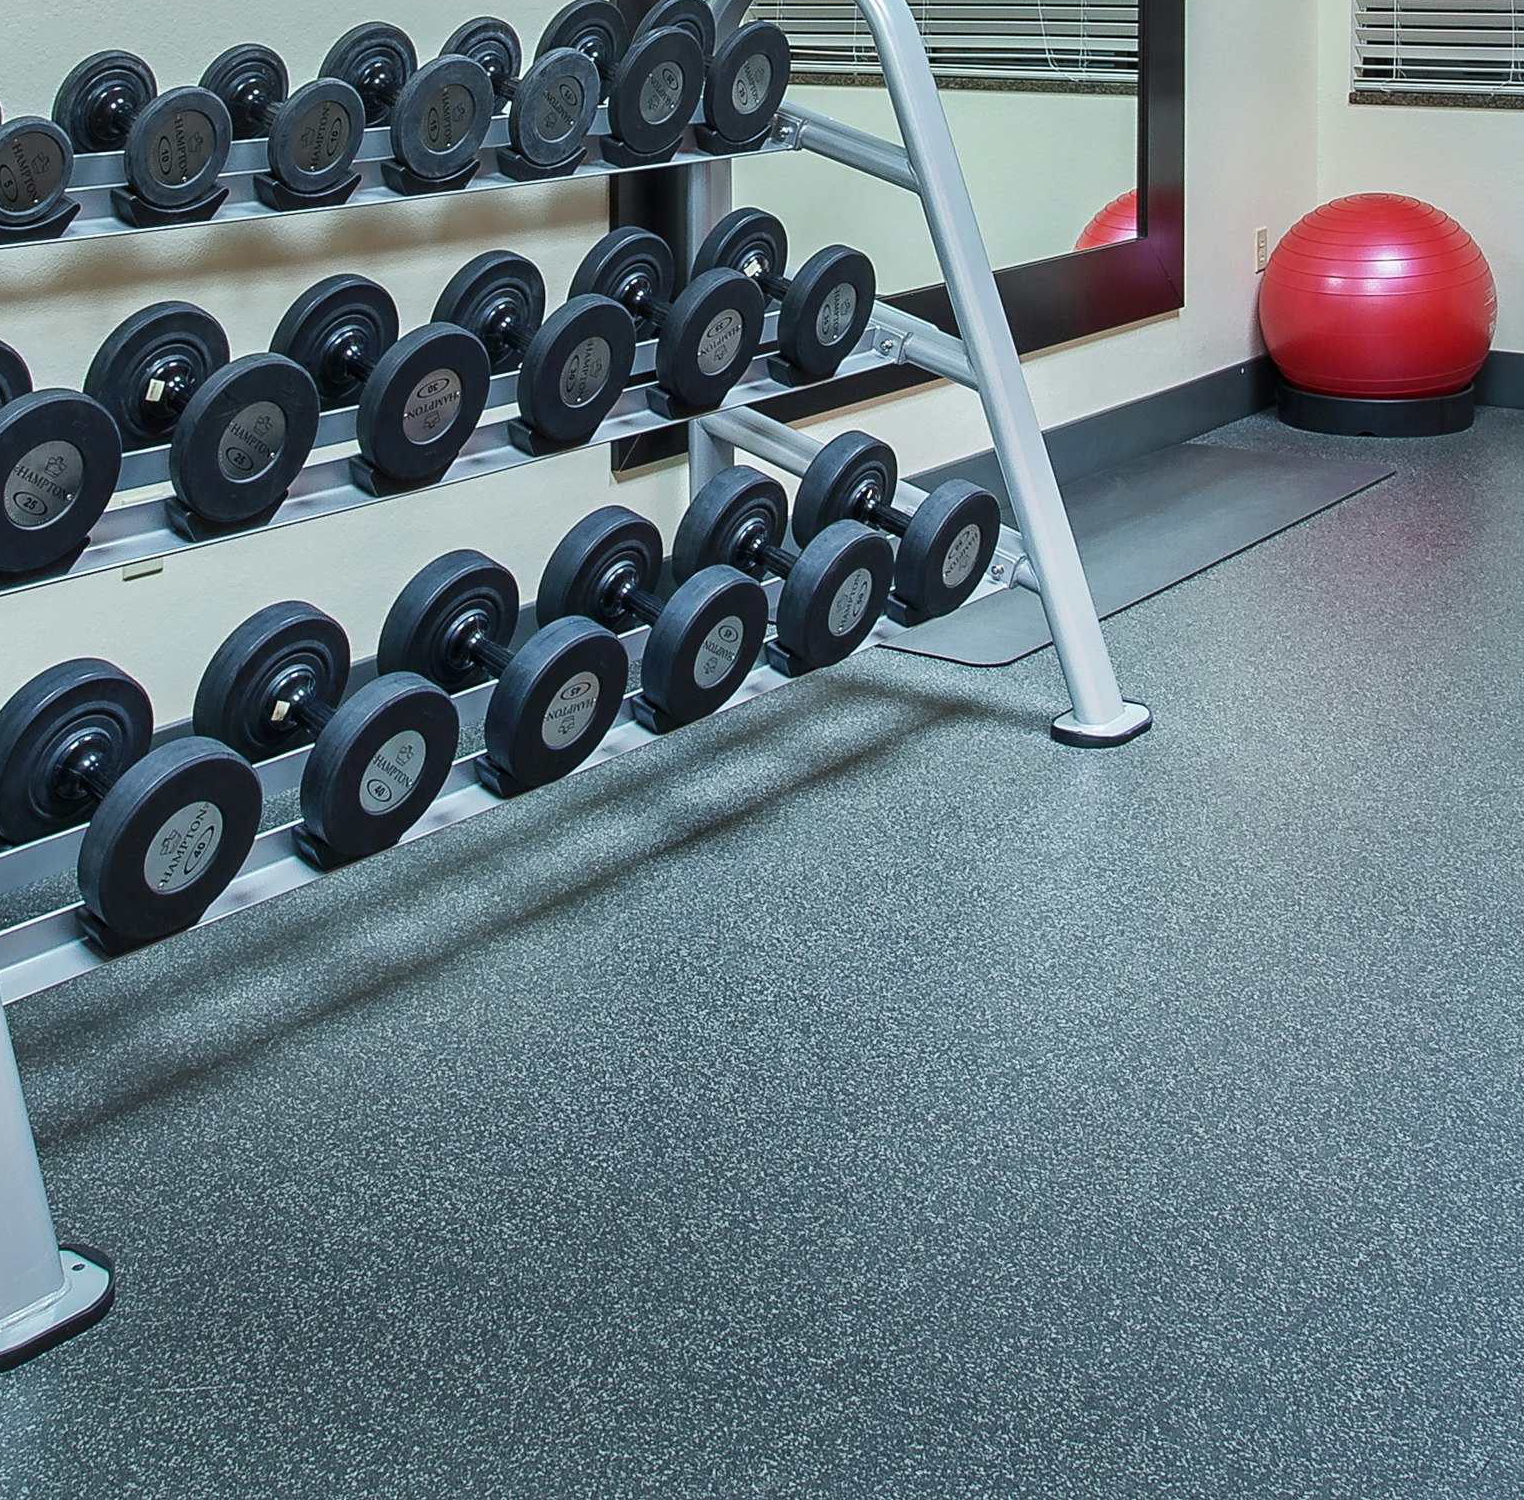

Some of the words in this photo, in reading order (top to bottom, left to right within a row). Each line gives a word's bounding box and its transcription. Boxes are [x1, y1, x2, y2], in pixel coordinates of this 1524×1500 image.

[310, 107, 330, 167] HAMPTON
[331, 130, 339, 143] 10
[161, 149, 169, 163] 10
[175, 118, 188, 179] HAMPTON
[12, 143, 39, 201] HAMPTON
[4, 180, 14, 189] 5
[569, 367, 577, 381] 30
[427, 382, 439, 394] 30
[406, 391, 460, 420] HAMPTON
[230, 423, 272, 459] HAMPTON
[233, 452, 246, 466] 25
[16, 465, 69, 502] HAMPTON
[22, 497, 38, 510] 25
[570, 686, 581, 697] 45
[546, 697, 596, 722] HAMPTON
[372, 753, 413, 788] HAMPTON
[374, 784, 386, 797] 40
[160, 808, 208, 884] HAMPTON
[193, 841, 206, 858] 40
